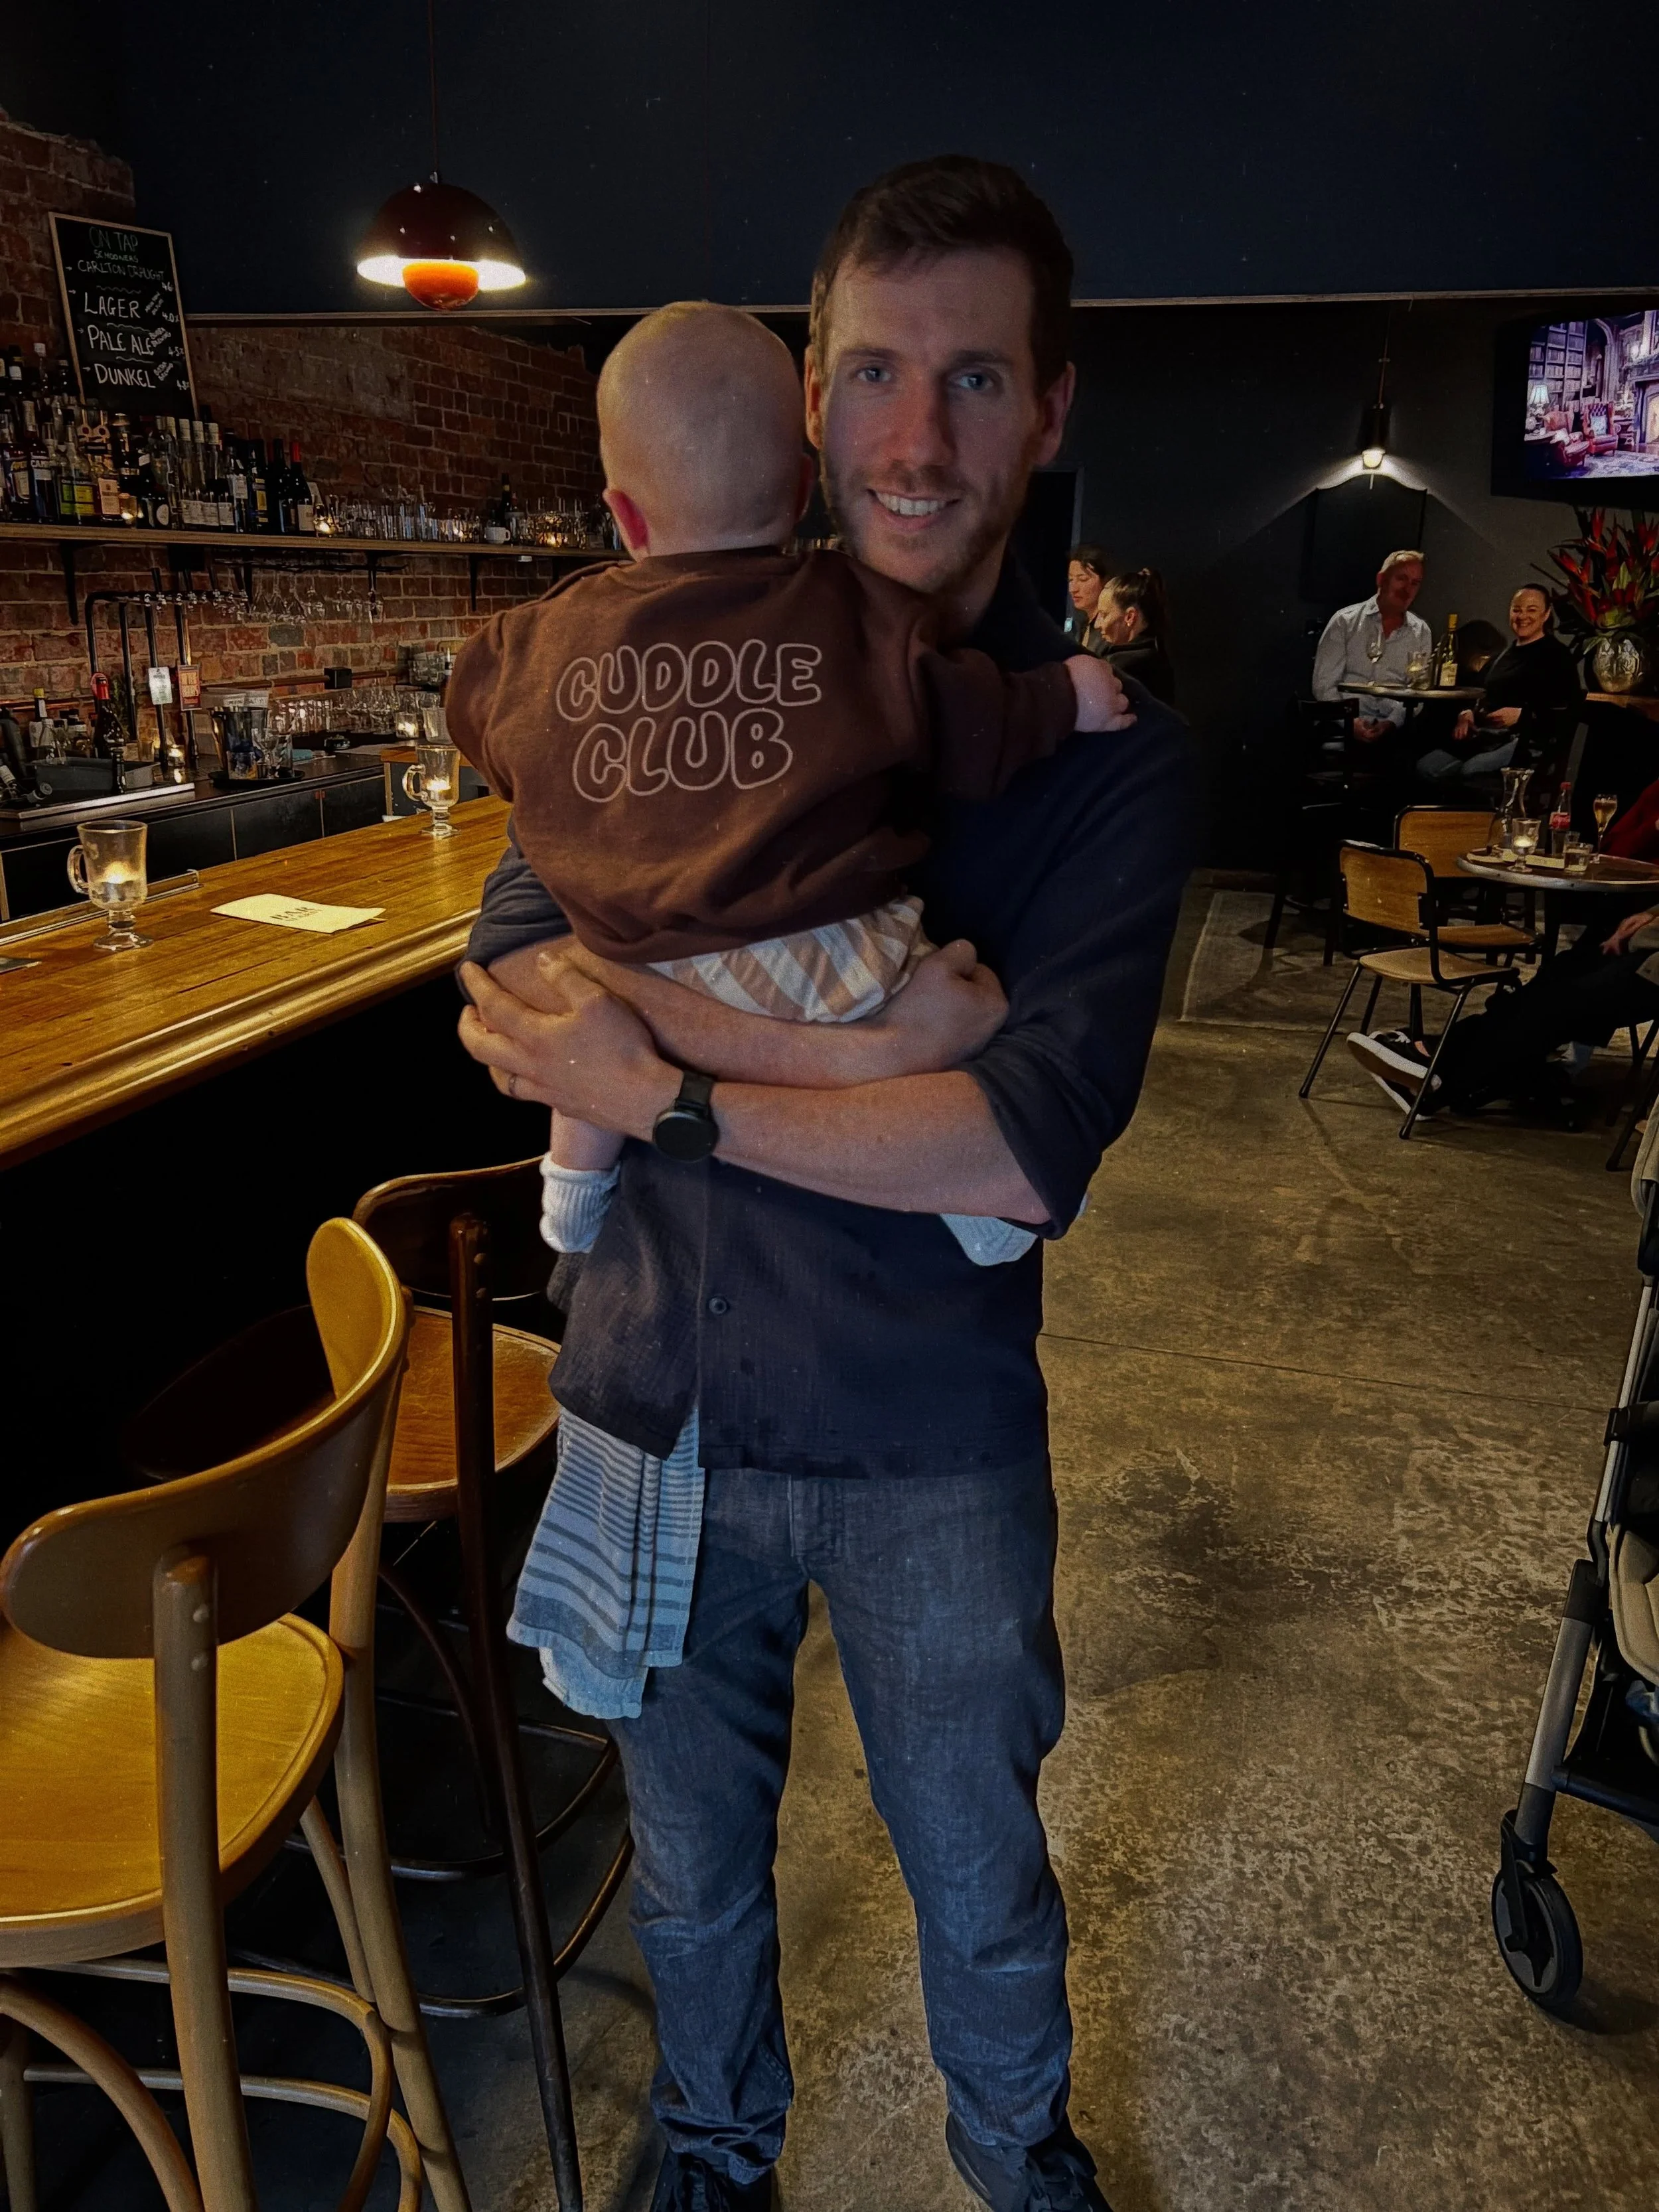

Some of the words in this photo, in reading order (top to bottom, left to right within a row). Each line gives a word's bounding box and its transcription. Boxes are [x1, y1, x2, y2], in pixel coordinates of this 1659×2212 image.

[88, 226, 111, 250] ON
[112, 232, 139, 252] TAP
[77, 259, 126, 276] CARLTON
[84, 291, 141, 319] LAGER
[87, 325, 127, 352] PALE
[131, 334, 155, 356] ALE
[94, 363, 157, 389] DUNKEL
[555, 638, 822, 722] CUDDLE
[572, 707, 794, 803] CLUB
[269, 907, 315, 921] BAR
